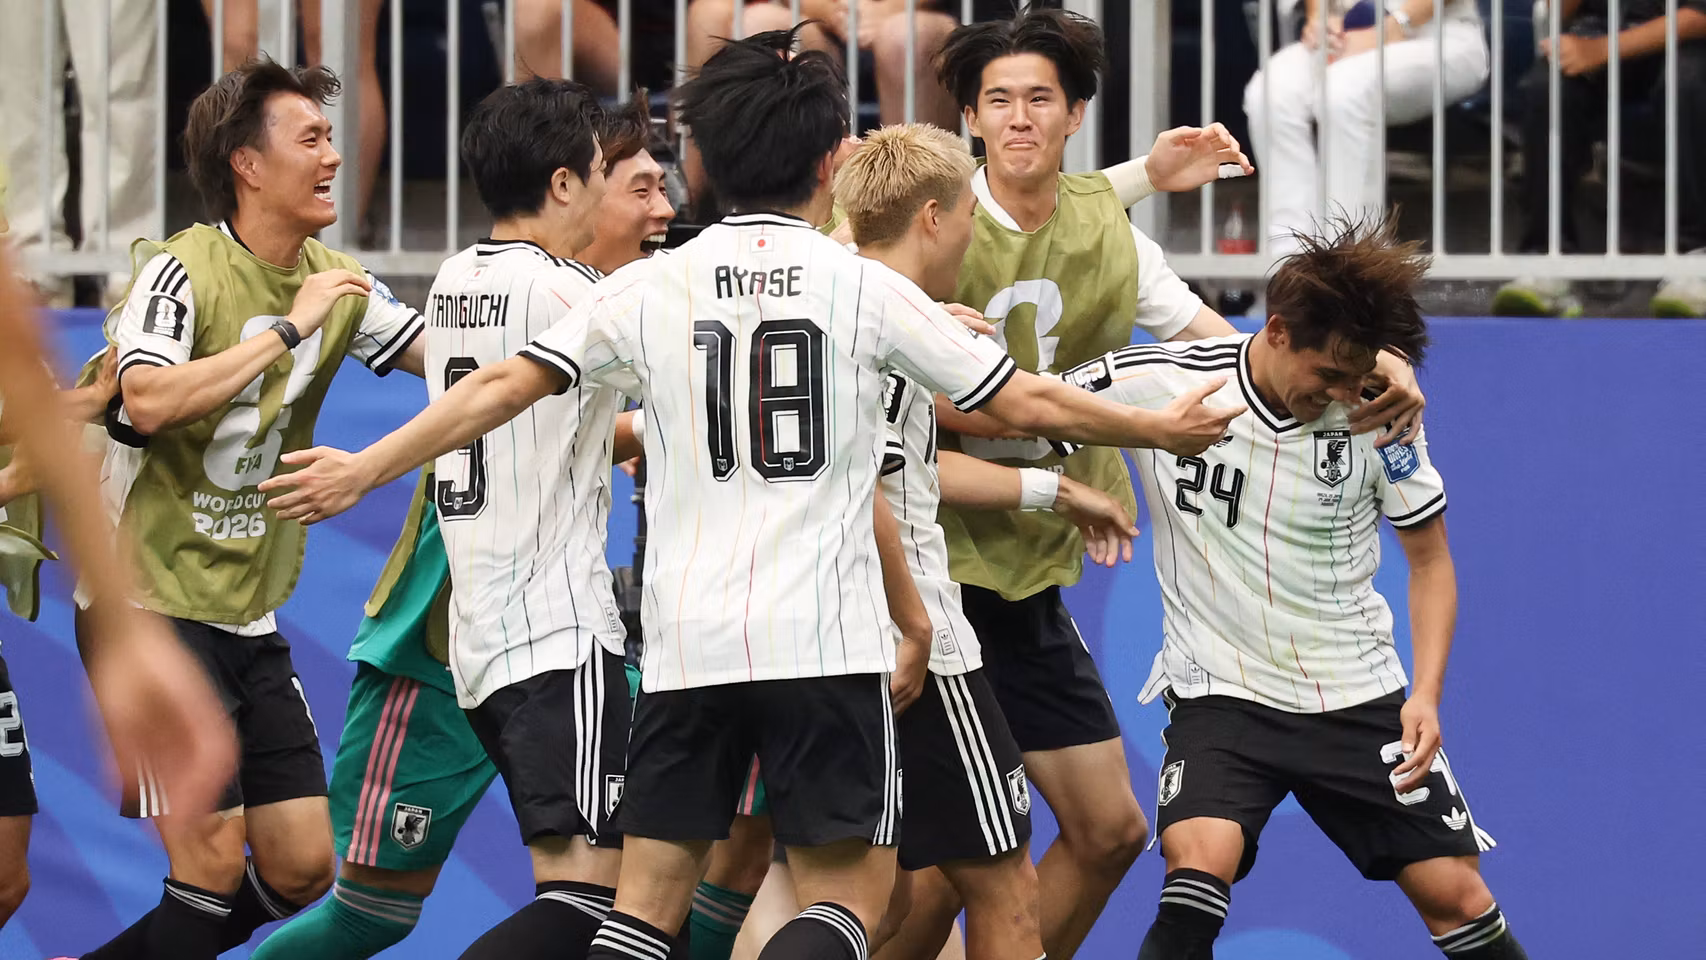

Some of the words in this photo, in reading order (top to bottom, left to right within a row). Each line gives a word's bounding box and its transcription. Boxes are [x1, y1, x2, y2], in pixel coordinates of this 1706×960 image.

[715, 265, 803, 299] AYASE
[431, 293, 509, 328] TANIGUCHI
[693, 318, 831, 483] 18
[1175, 454, 1247, 530] 24
[191, 511, 267, 541] 2026
